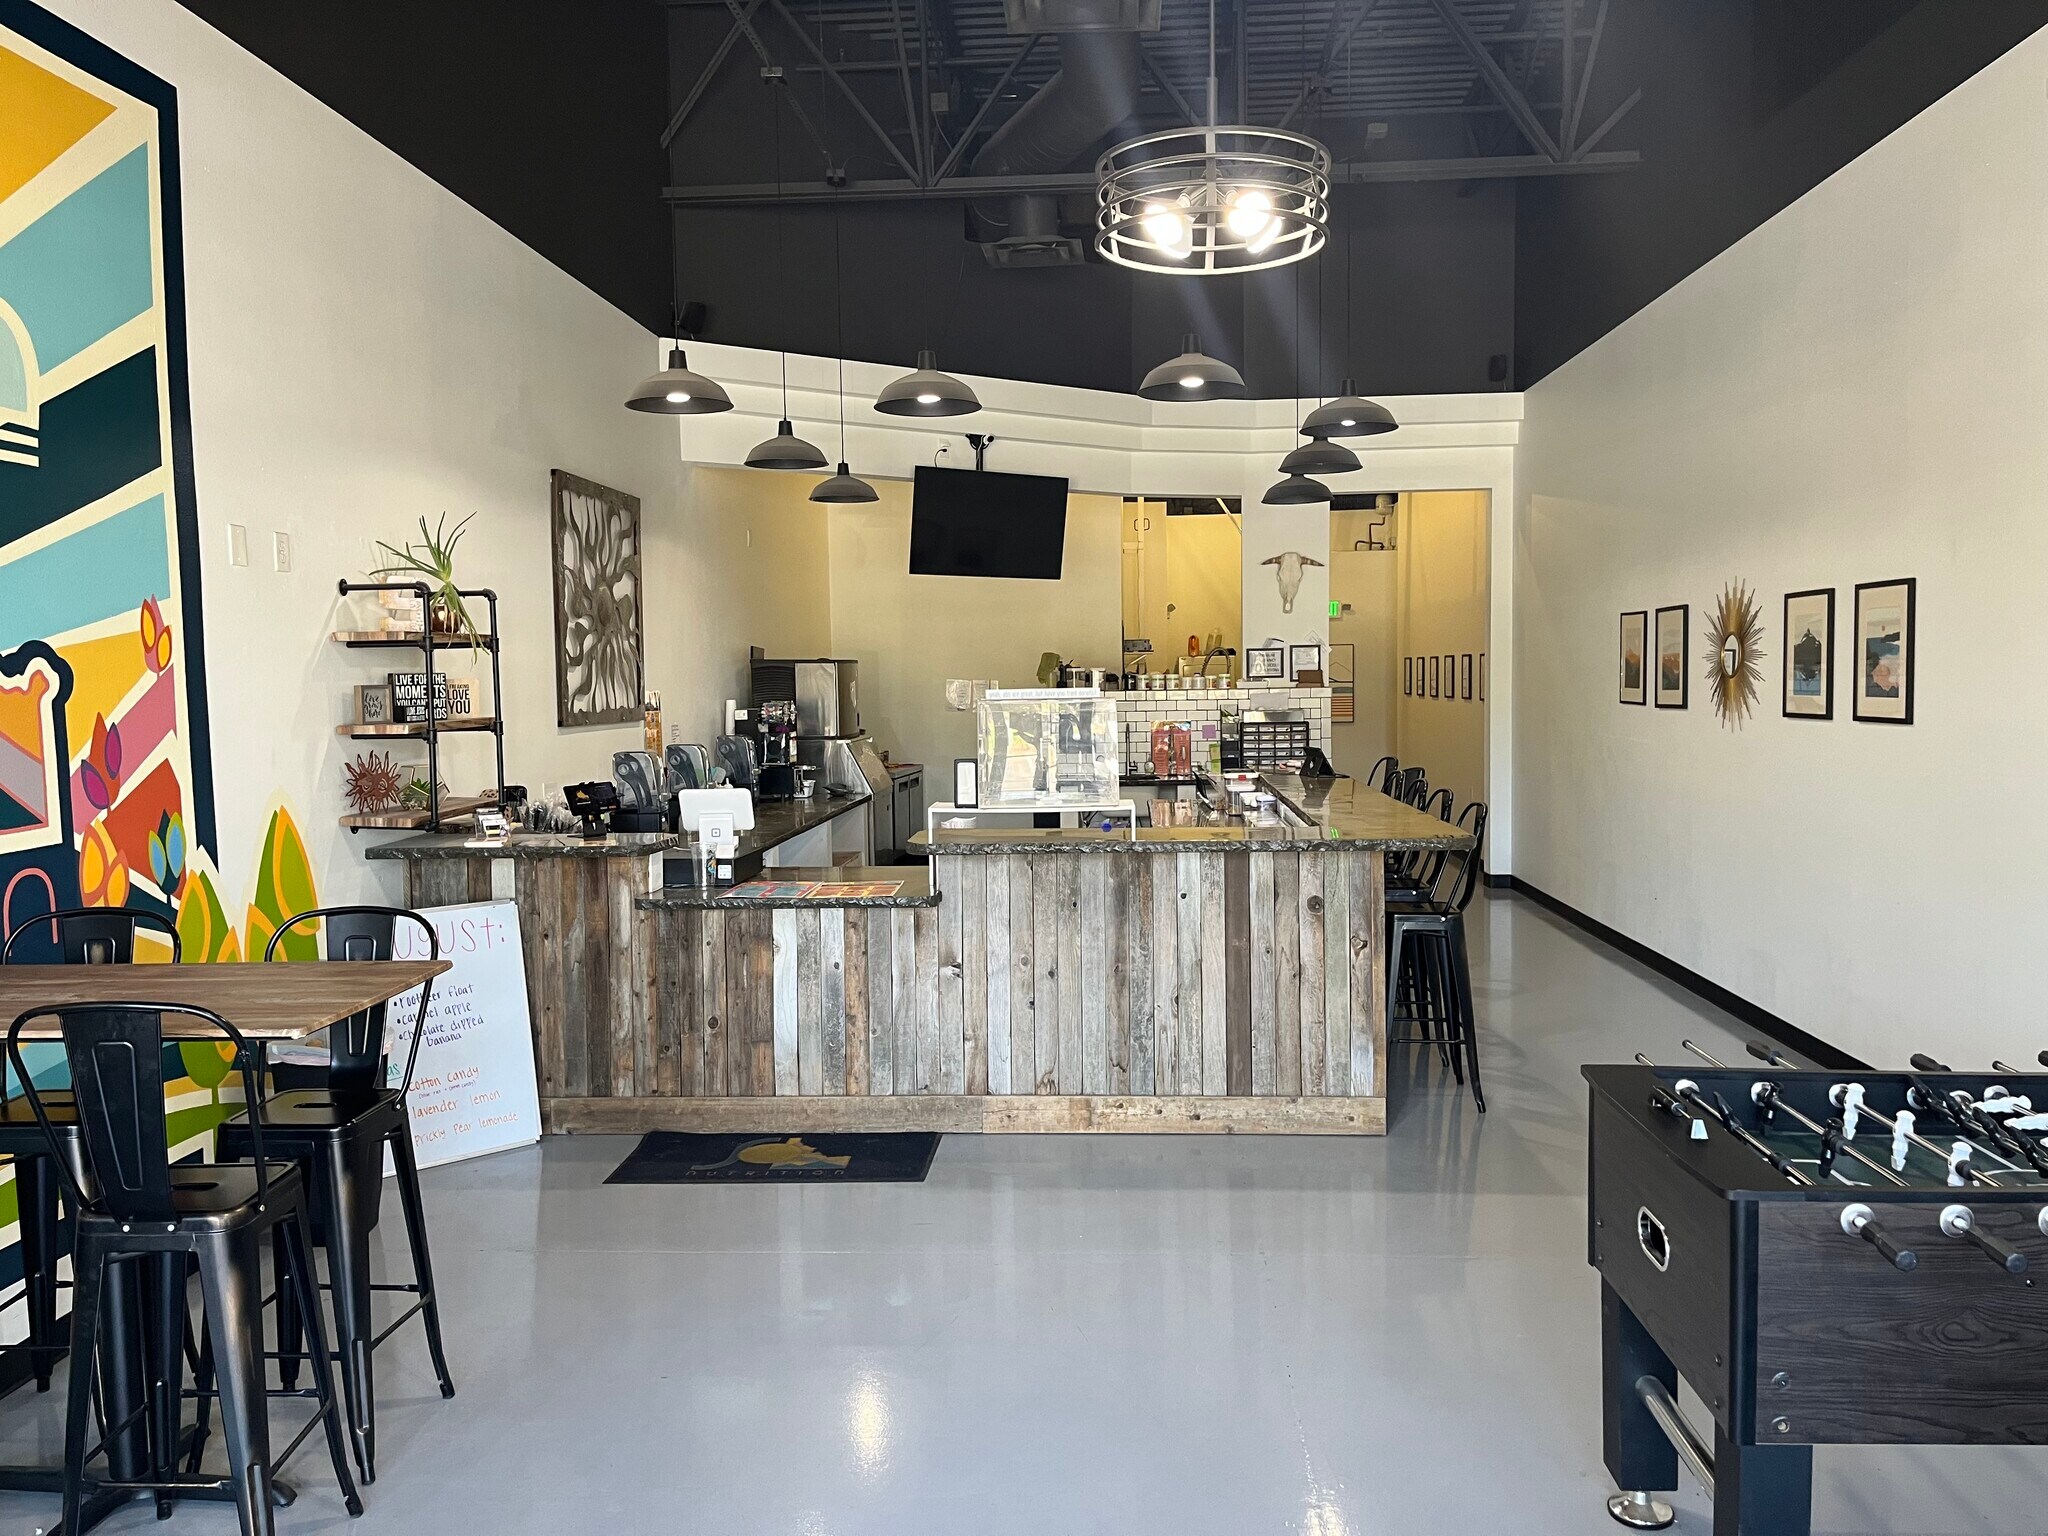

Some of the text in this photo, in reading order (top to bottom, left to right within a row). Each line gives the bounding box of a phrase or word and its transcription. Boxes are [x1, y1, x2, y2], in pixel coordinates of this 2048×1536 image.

[395, 674, 413, 685] LIVE
[414, 674, 427, 685] FO
[396, 685, 446, 699] MOMETS
[447, 689, 470, 701] LOVE
[412, 698, 428, 706] CAN'
[433, 698, 446, 708] PUT
[447, 700, 471, 715] YOU
[399, 983, 475, 1009] rooter float
[444, 1001, 472, 1017] apple
[450, 1014, 485, 1031] dipped
[426, 1032, 463, 1047] banana
[411, 1090, 502, 1119] lavender lemon
[478, 1112, 519, 1129] lemonade
